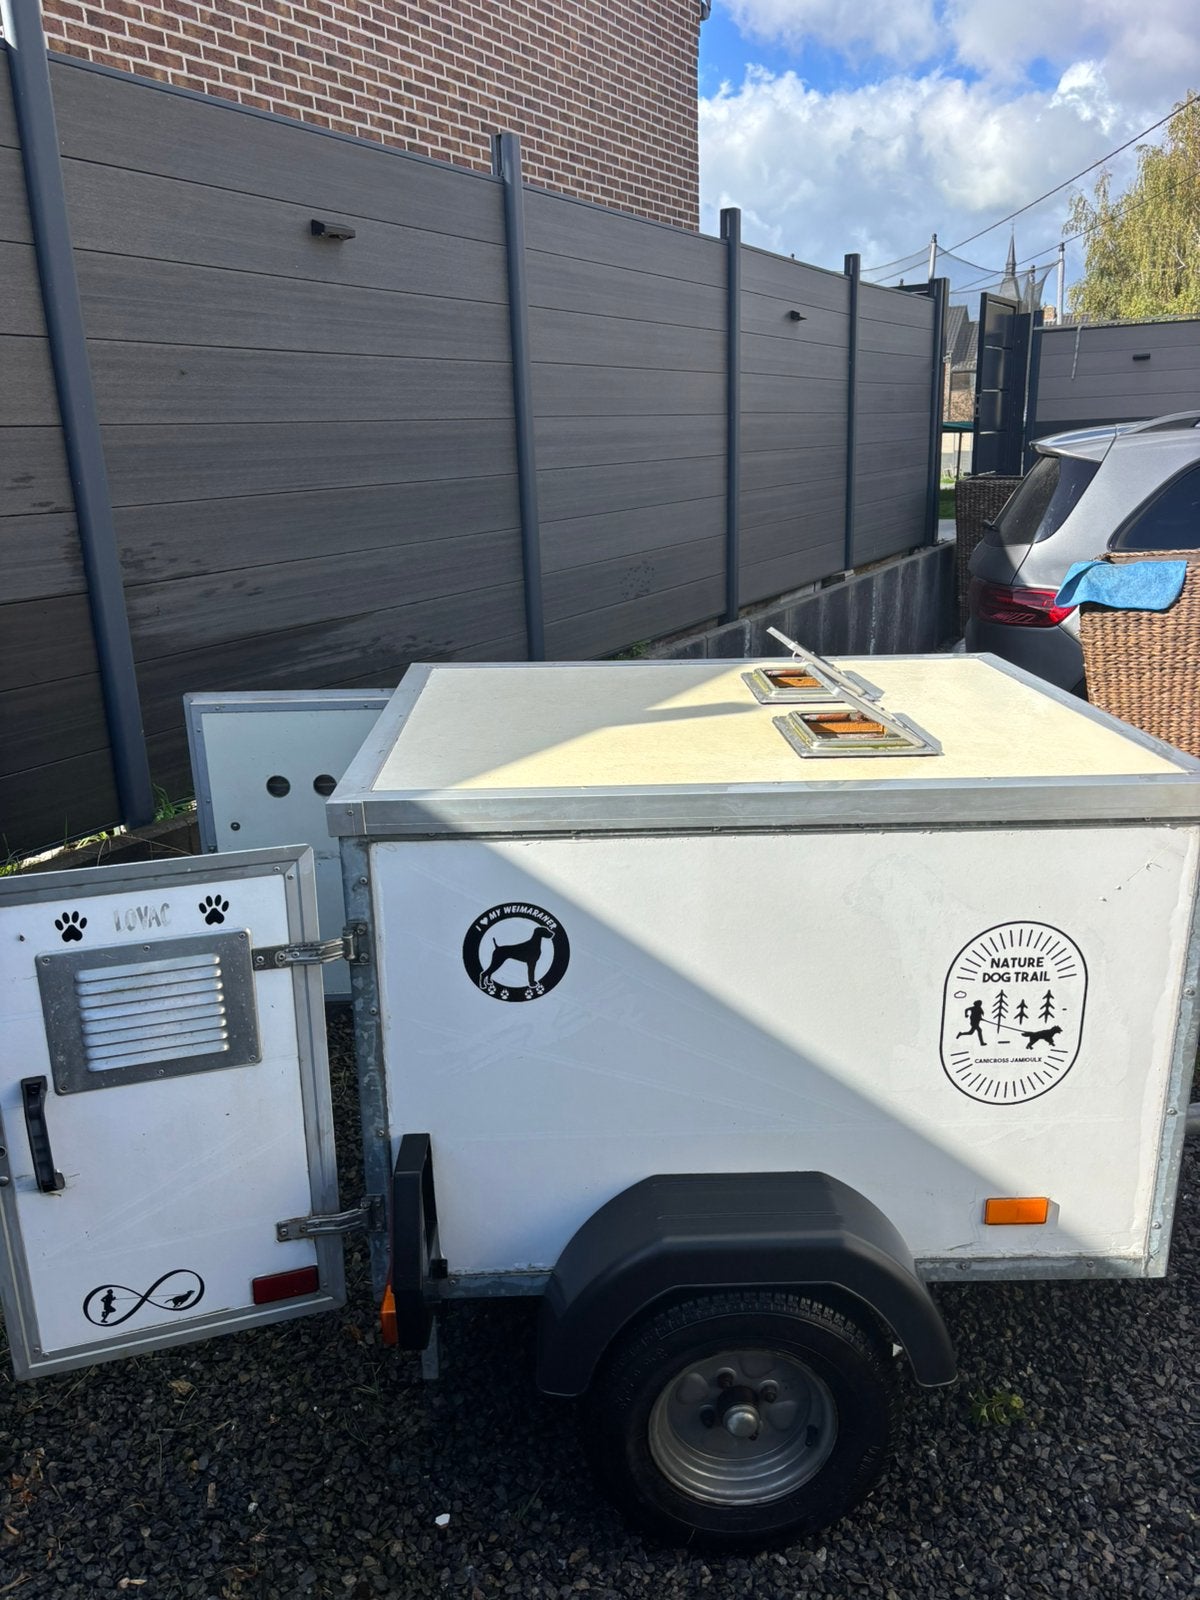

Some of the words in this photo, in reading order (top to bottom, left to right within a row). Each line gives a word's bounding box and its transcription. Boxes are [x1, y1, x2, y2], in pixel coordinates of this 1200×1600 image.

[488, 909, 501, 920] MY
[503, 905, 557, 929] WEIMARANER
[990, 957, 1045, 968] NATURE
[982, 972, 1011, 983] DOG
[1014, 971, 1051, 982] TRAIL
